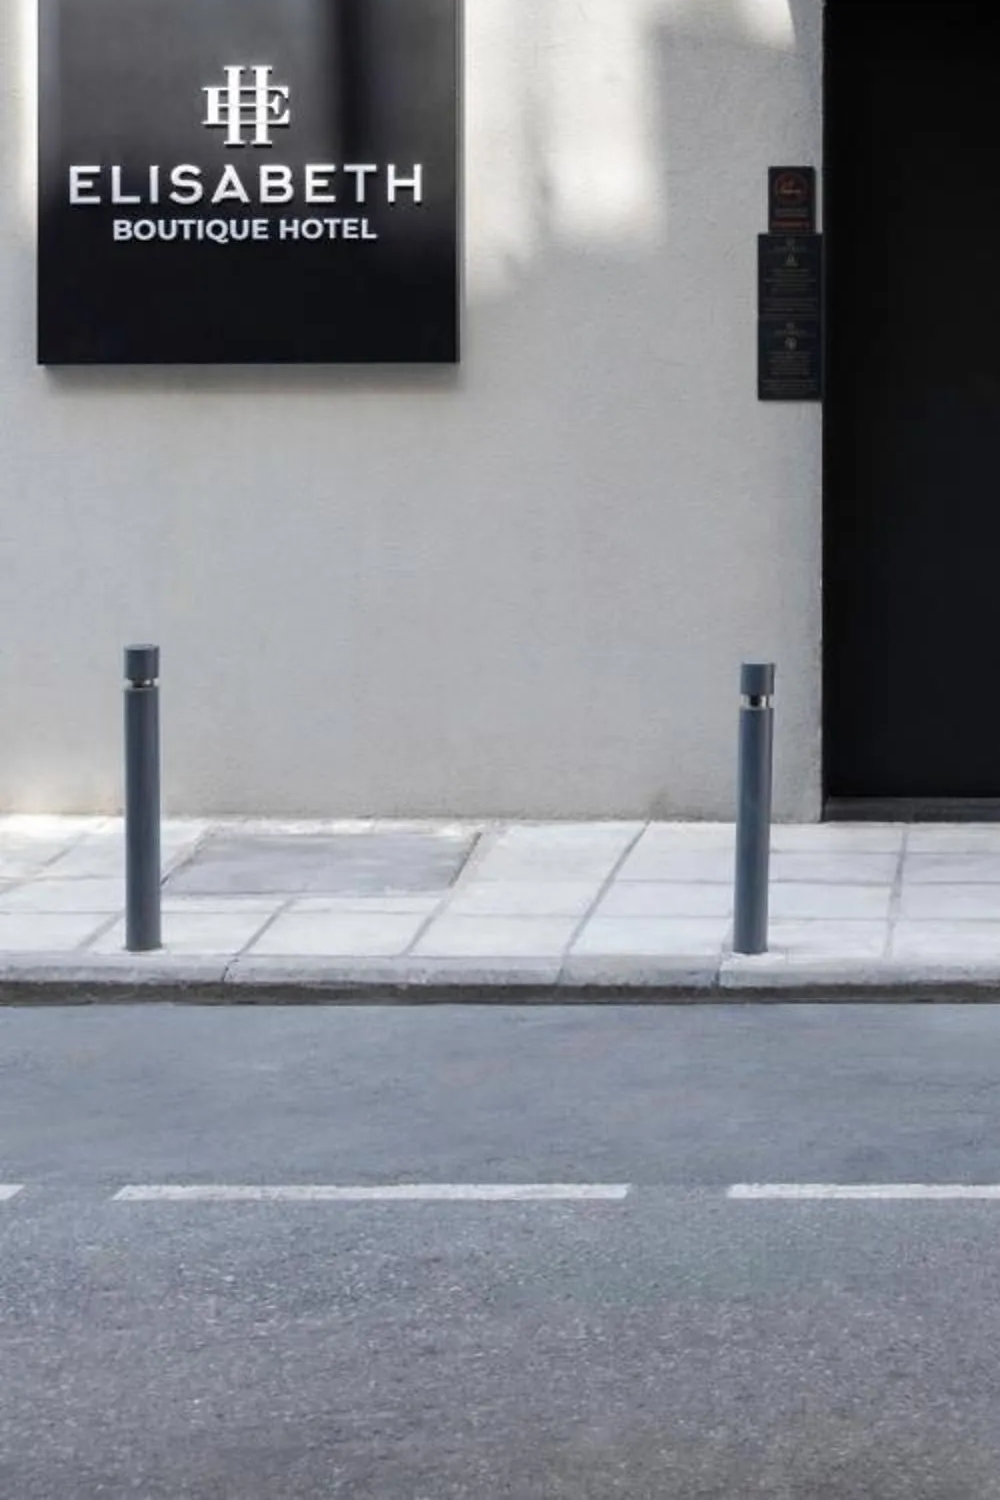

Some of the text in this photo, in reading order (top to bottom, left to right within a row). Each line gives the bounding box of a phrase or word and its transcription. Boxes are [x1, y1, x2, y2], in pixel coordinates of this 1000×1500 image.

[69, 163, 423, 204] ELISABETH
[112, 218, 377, 243] BOUTIQUE HOTEL
